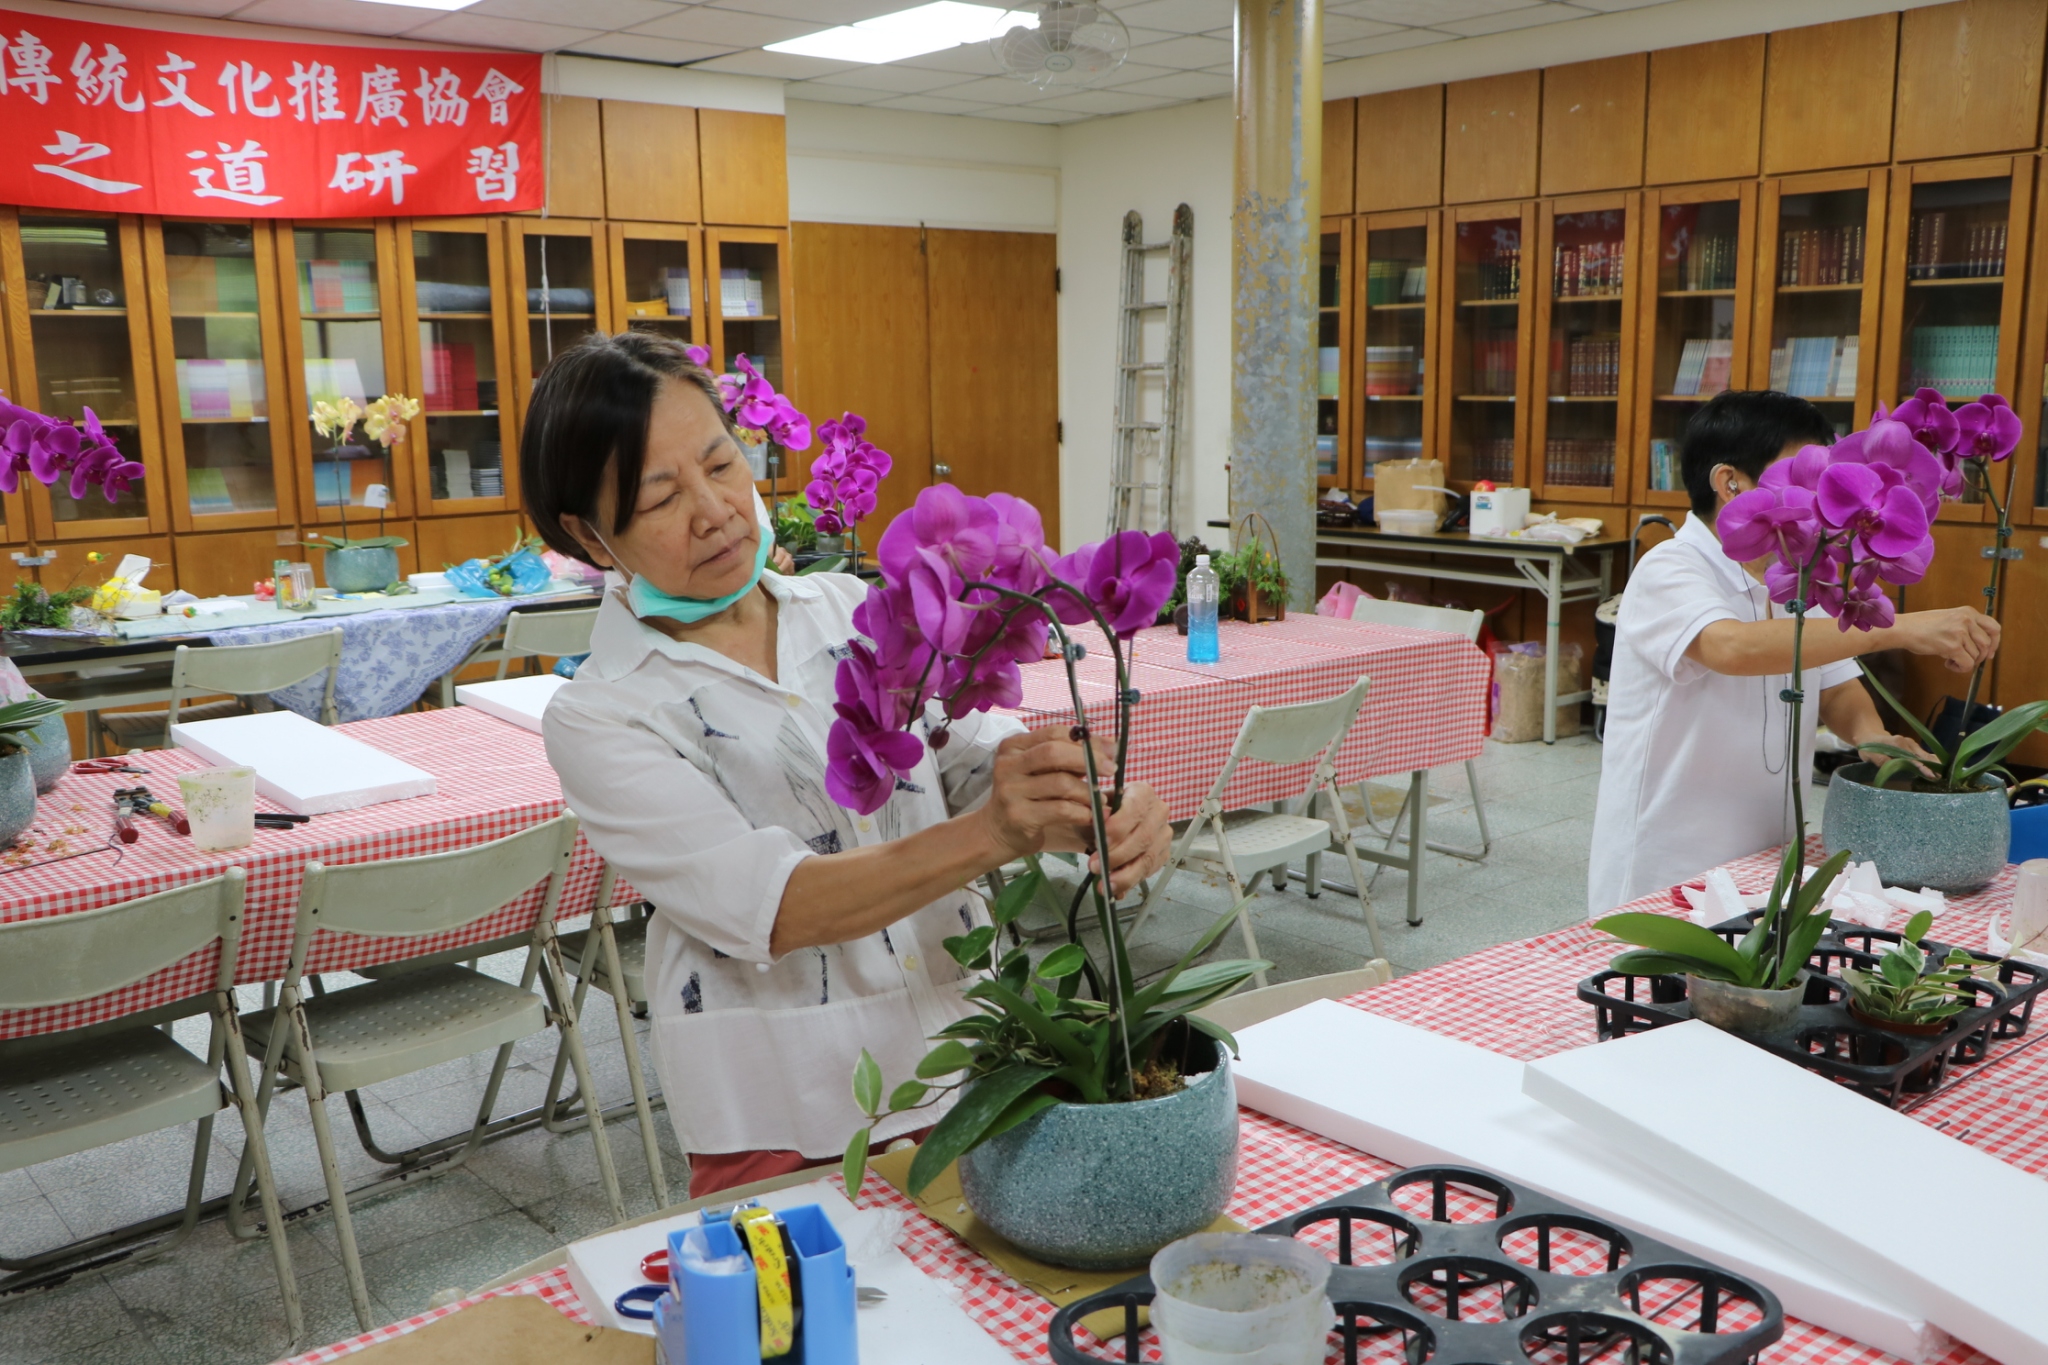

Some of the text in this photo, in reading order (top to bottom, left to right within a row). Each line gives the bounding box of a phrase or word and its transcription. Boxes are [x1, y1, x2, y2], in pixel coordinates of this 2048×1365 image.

[0, 29, 524, 128] 傳統文化推廣協會
[33, 129, 520, 206] 之道研習
